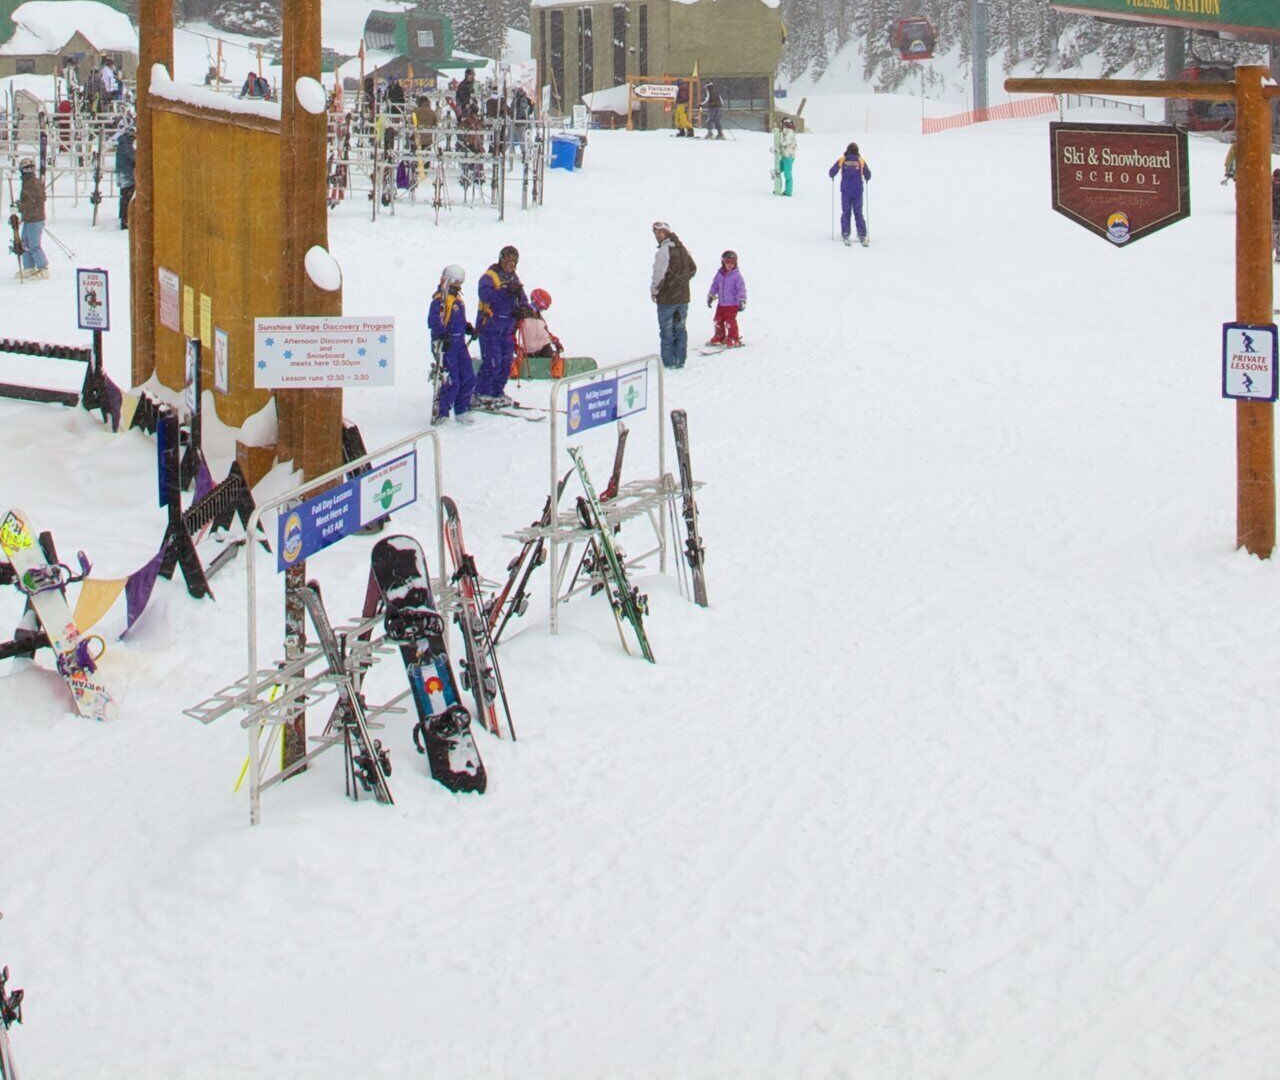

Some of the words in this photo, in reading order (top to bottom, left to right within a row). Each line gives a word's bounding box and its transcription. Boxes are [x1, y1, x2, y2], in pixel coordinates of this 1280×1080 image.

[1063, 145, 1085, 165] Ski
[1087, 147, 1100, 166] &
[1101, 148, 1171, 169] Snowboard
[1075, 170, 1160, 185] SCHOOL
[258, 323, 293, 331] Sunshine
[295, 323, 320, 332] Village
[322, 323, 360, 332] Discovery
[362, 323, 394, 332] Program
[1232, 353, 1267, 364] PRIVATE
[1230, 362, 1269, 372] LESSONS
[311, 502, 324, 516] Full
[323, 498, 334, 512] Day
[333, 488, 353, 503] Lessons
[315, 513, 330, 527] Meet
[329, 507, 343, 521] Here
[342, 503, 349, 514] at
[322, 524, 335, 538] 9:45
[334, 519, 344, 531] AM
[71, 678, 96, 692] RYAN
